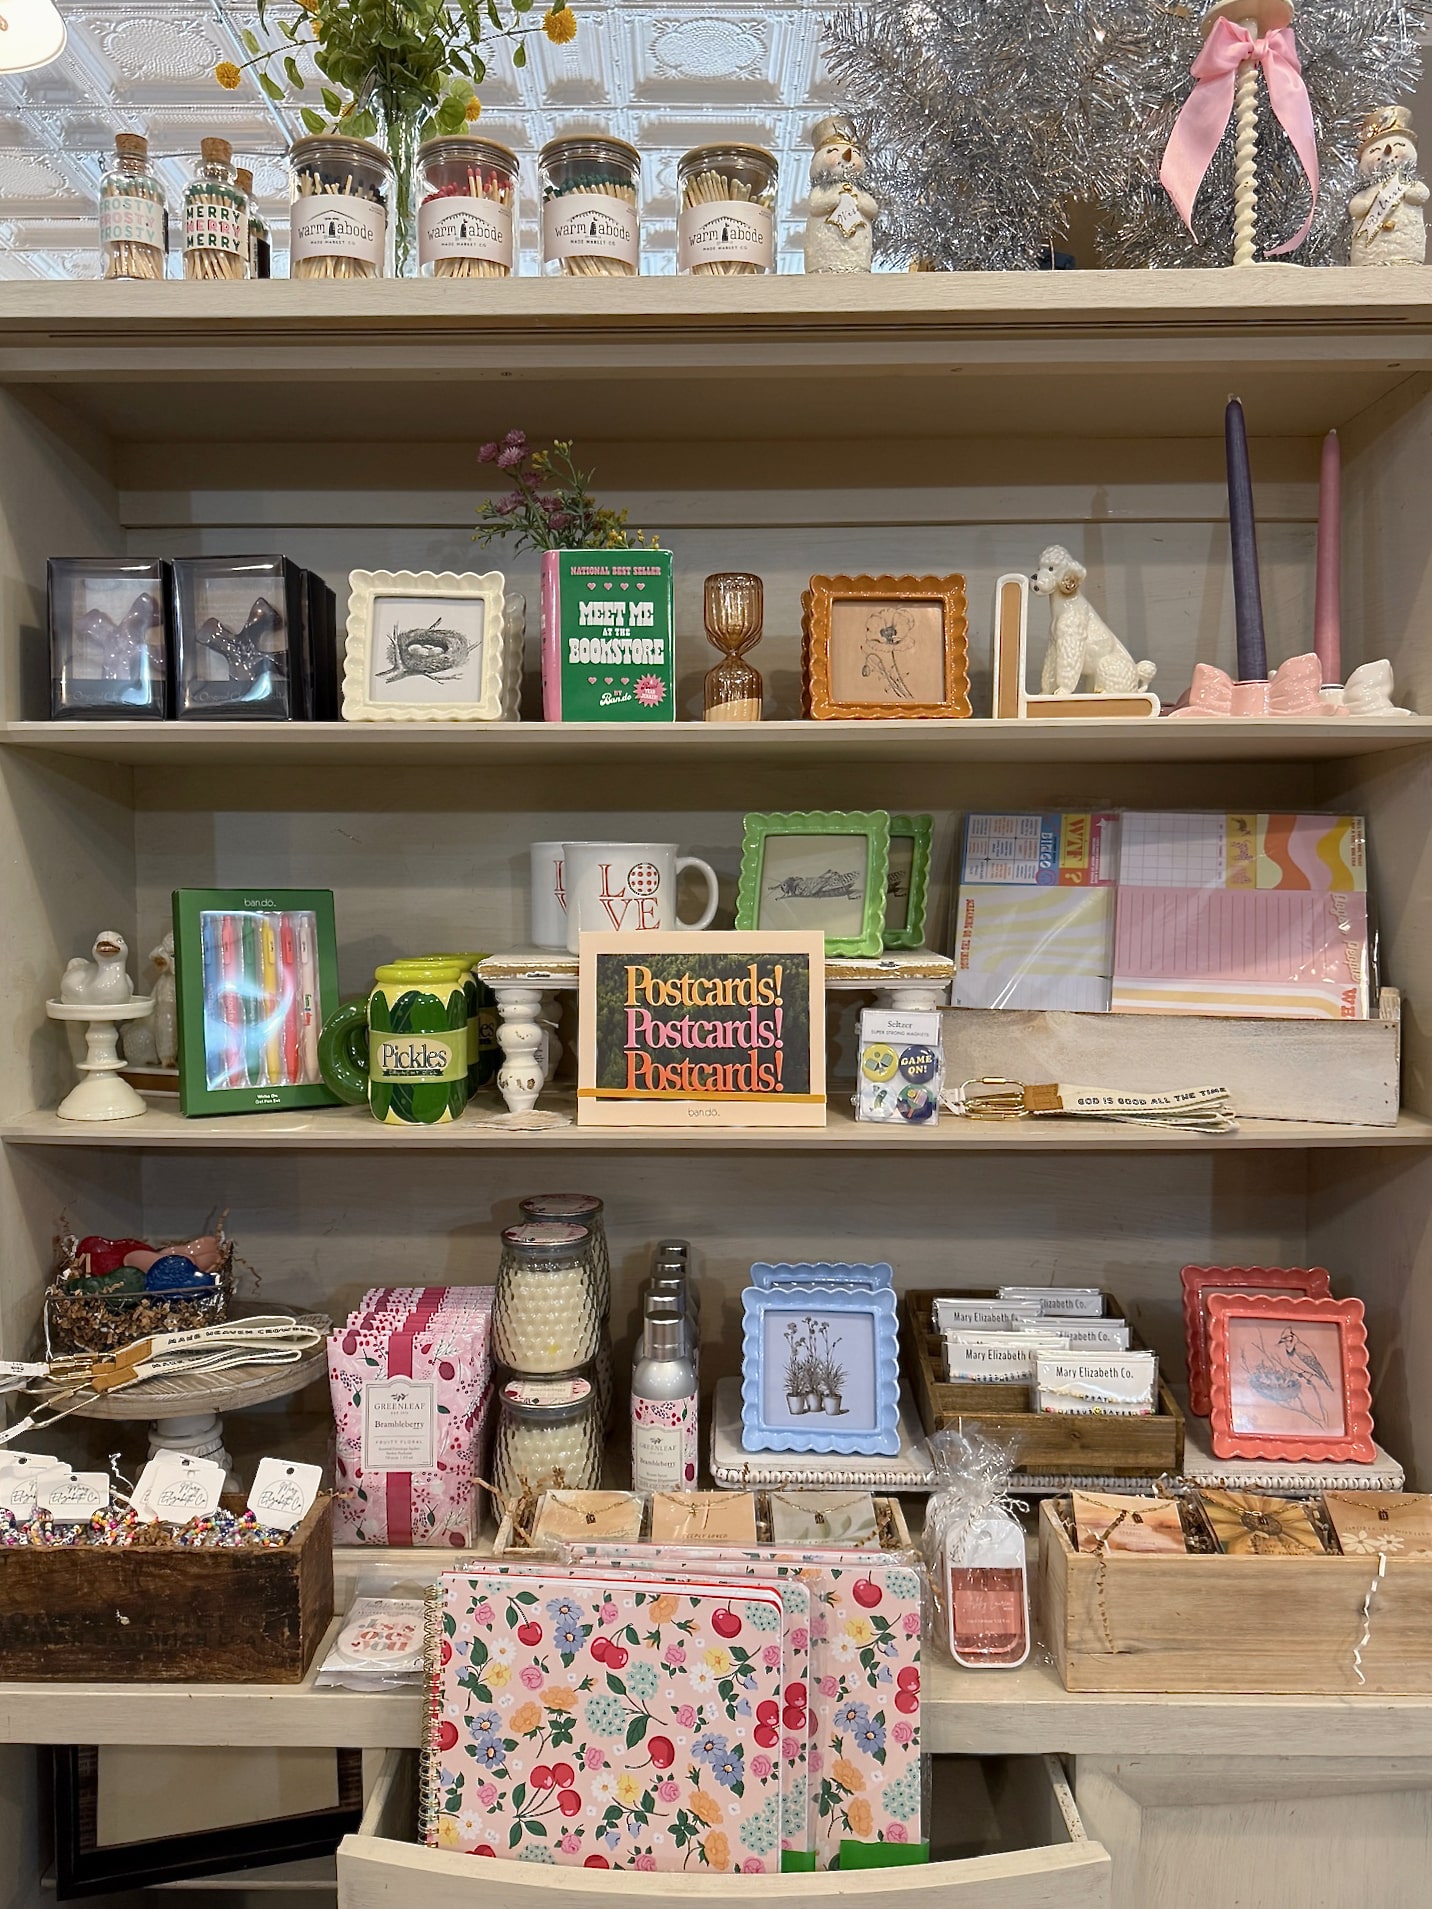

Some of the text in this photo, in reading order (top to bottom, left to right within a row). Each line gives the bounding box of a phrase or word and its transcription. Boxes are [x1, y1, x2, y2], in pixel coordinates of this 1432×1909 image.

[101, 199, 154, 213] FROSTY
[187, 206, 240, 224] MERRY
[101, 225, 155, 242] FROSTY
[187, 219, 241, 239] MERRY
[298, 220, 374, 242] warm abode
[428, 223, 503, 244] warm abode
[555, 221, 631, 242] warm abode
[689, 226, 764, 246] warm abode
[187, 233, 241, 251] MERRY
[570, 566, 661, 576] NATIONAL BEST SELLER
[579, 601, 654, 627] MEET ME
[602, 627, 631, 637] AT THE
[568, 637, 665, 666] BOOKSTORE
[1065, 816, 1084, 862] WTF
[1039, 832, 1054, 869] BINGO
[623, 964, 784, 1008] Postcards!
[623, 1006, 784, 1049] Postcards!
[382, 1043, 448, 1069] Pickles
[901, 1055, 933, 1066] GAME
[623, 1049, 784, 1093] Postcards!
[908, 1065, 928, 1075] ON!
[1173, 1094, 1197, 1102] THE
[1200, 1087, 1227, 1096] TIME
[1075, 1299, 1087, 1310] Co.
[953, 1312, 973, 1323] Mary
[974, 1312, 1010, 1323] Elizabeth
[1098, 1331, 1111, 1342] Co.
[965, 1349, 986, 1361] Mary
[988, 1349, 1026, 1361] Elizabeth
[1056, 1366, 1135, 1379] Mary Elizabeth Co.
[375, 1421, 424, 1430] Brambleberry
